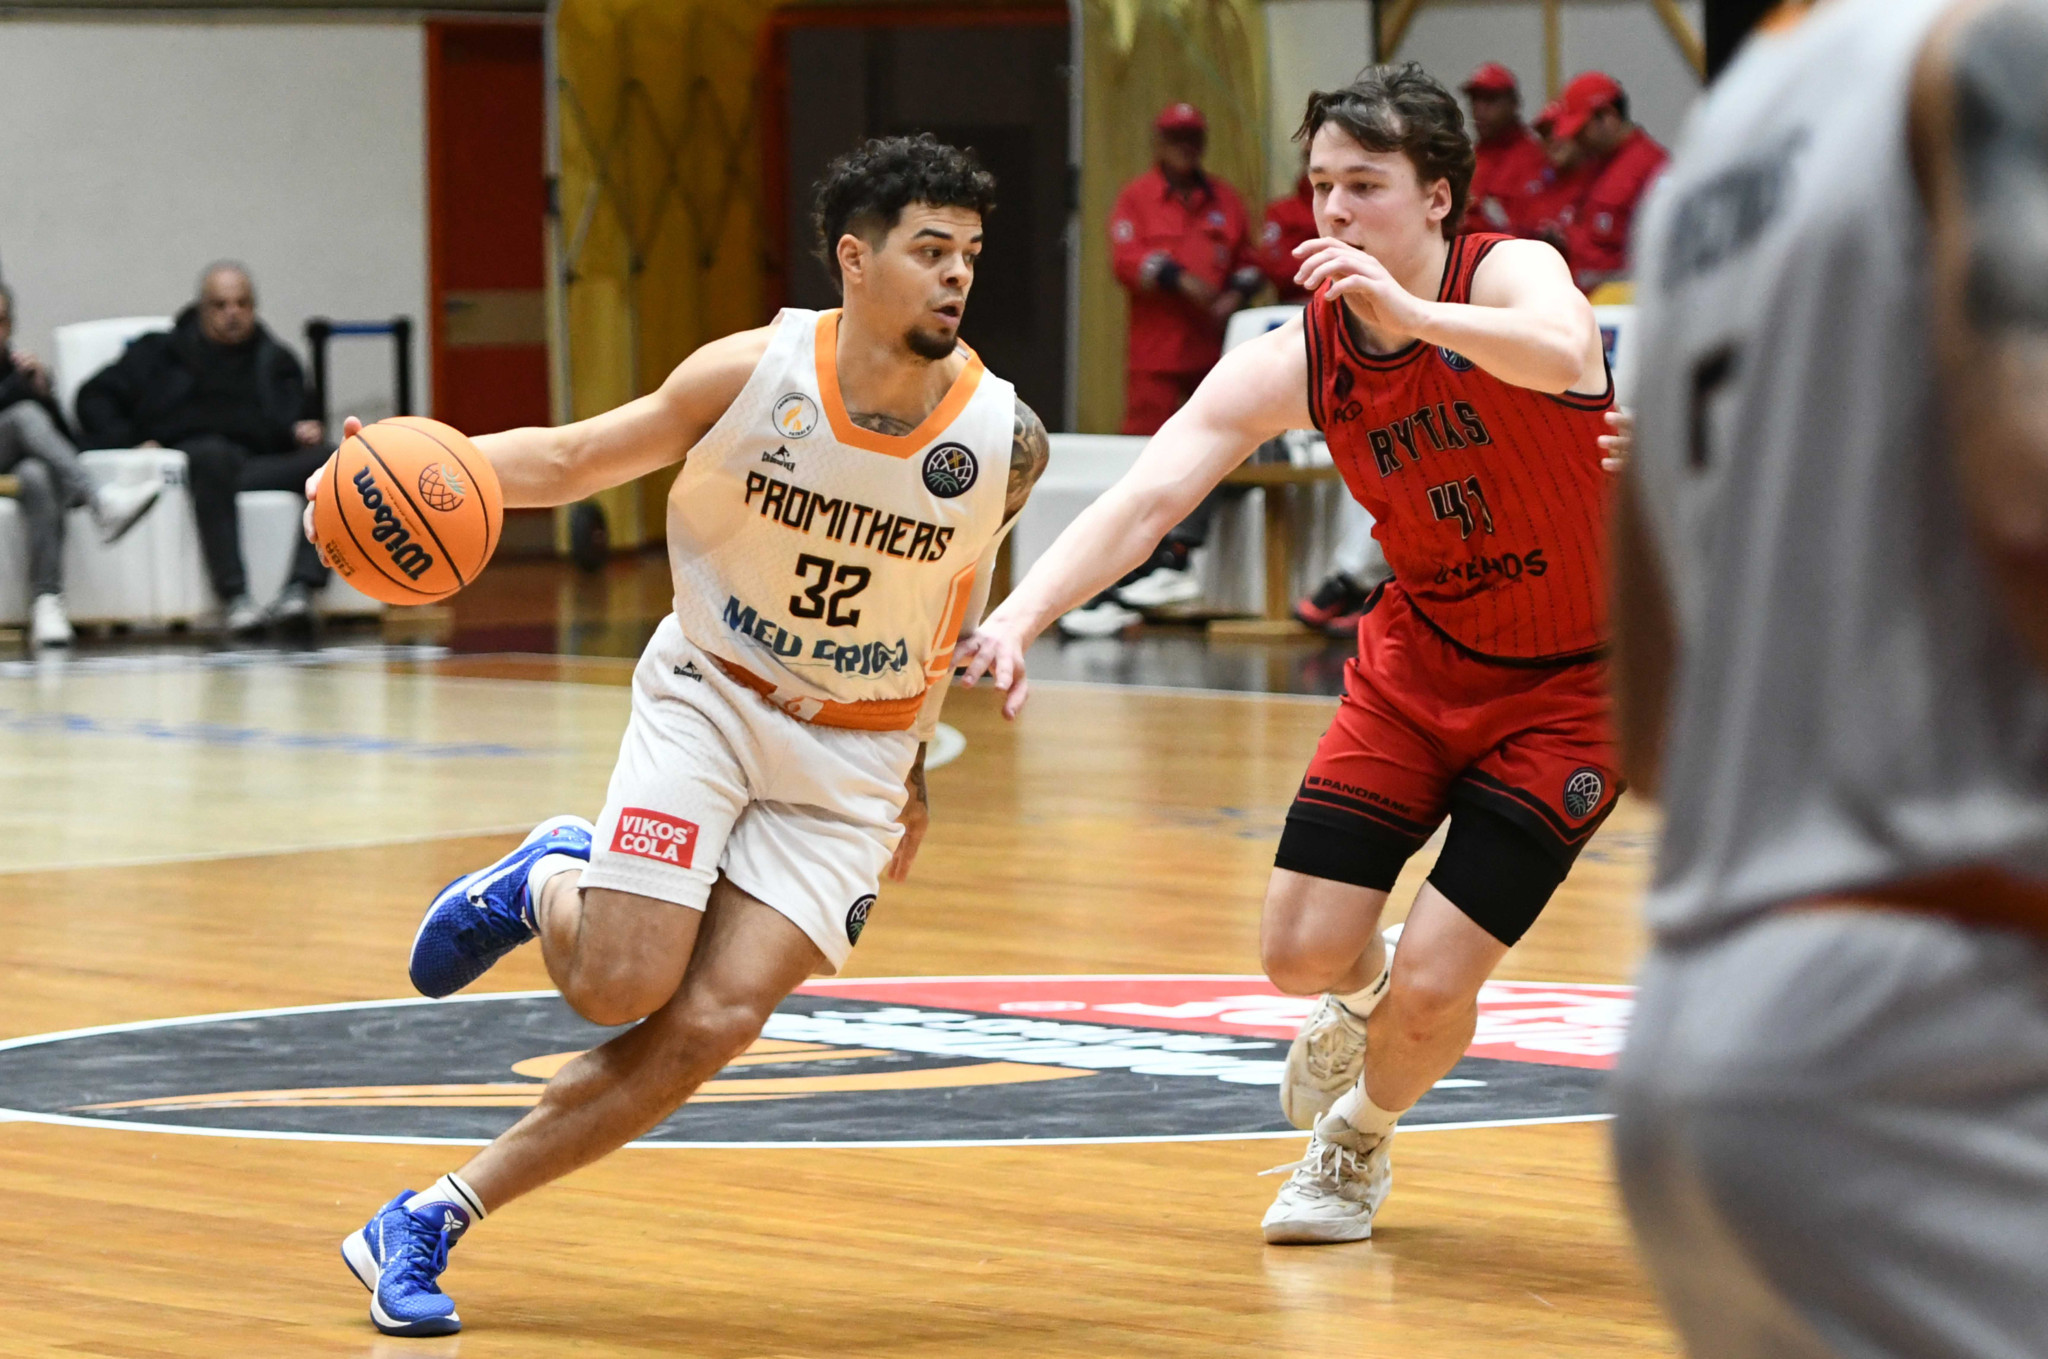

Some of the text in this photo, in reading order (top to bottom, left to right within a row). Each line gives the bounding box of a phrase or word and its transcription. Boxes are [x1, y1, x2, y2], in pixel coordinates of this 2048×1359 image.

[1366, 400, 1490, 478] RYTAS
[353, 465, 433, 581] Wilson
[745, 470, 956, 563] PROMITHEAS
[1426, 474, 1493, 540] 41
[789, 553, 872, 628] 32
[620, 833, 679, 862] COLA
[622, 815, 688, 845] VIKOS
